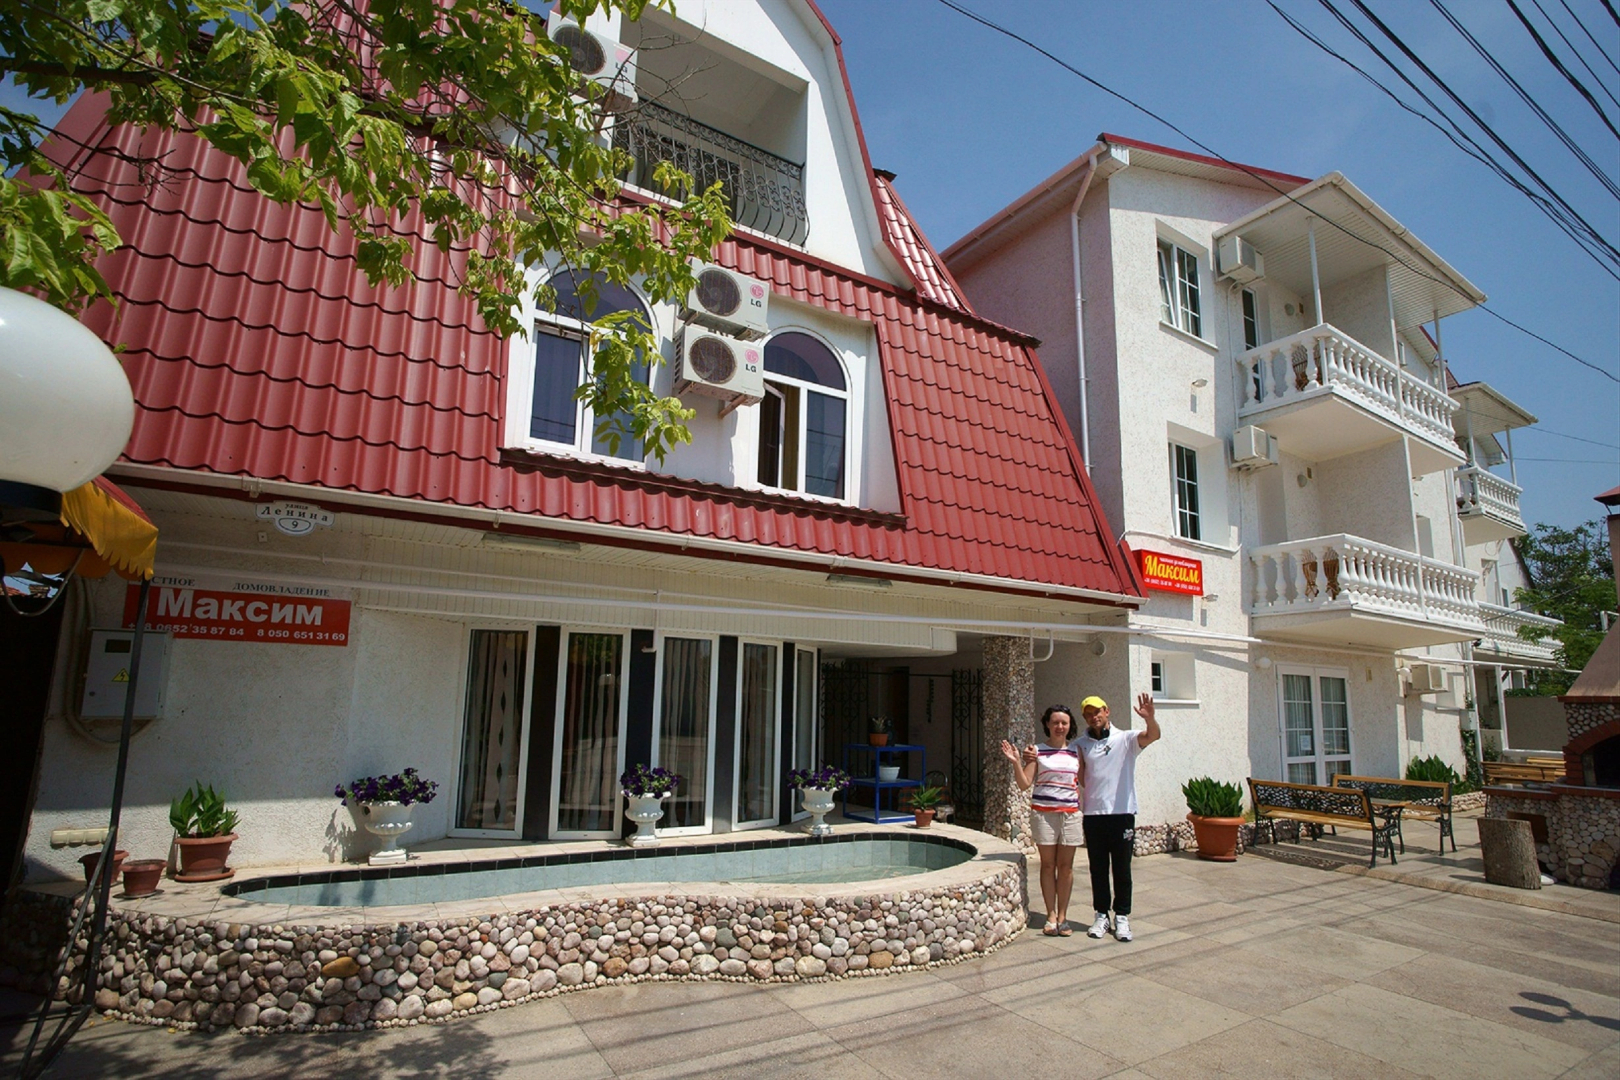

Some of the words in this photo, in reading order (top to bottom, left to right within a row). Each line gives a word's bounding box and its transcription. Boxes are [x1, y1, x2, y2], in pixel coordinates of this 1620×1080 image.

[750, 298, 762, 308] LG
[745, 363, 757, 373] LG
[261, 506, 328, 522] Ленина
[291, 520, 299, 528] 9
[1144, 554, 1200, 584] Максим
[143, 575, 195, 587] СТНОЕ
[232, 582, 330, 597] ДОМОВЛАДЕНИЕ
[156, 587, 323, 626] Максим
[192, 625, 208, 634] 35
[210, 626, 226, 635] 87
[229, 627, 244, 636] 84
[257, 629, 264, 637] 8
[268, 629, 290, 638] 050
[293, 631, 314, 639] 651
[316, 632, 329, 640] 31
[331, 633, 346, 641] 69
